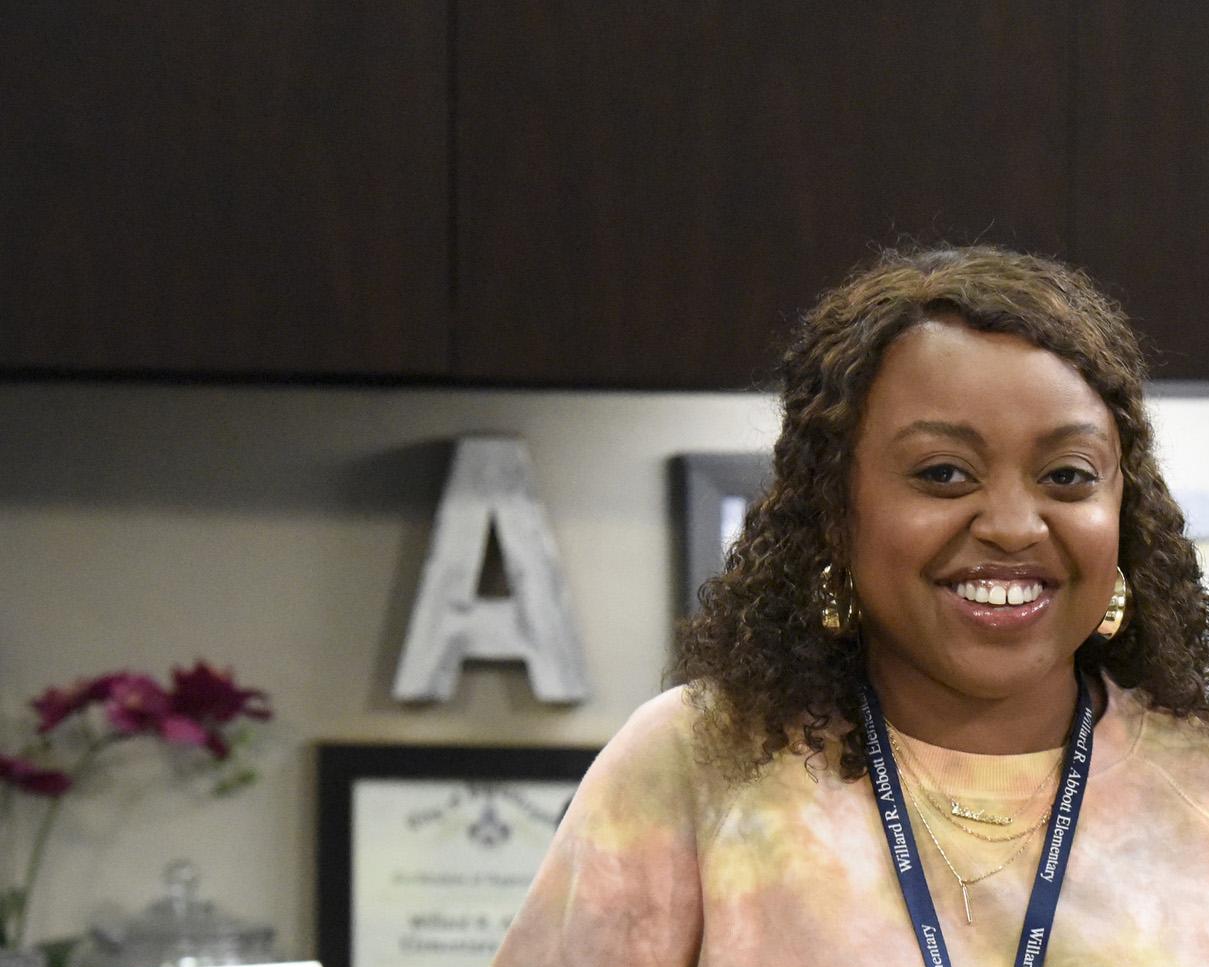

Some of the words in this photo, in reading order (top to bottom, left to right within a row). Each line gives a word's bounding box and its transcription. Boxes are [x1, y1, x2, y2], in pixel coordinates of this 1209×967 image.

[393, 438, 593, 702] A
[1076, 706, 1093, 753] Willard
[876, 758, 897, 802] Abbott
[1072, 750, 1087, 764] R.
[885, 804, 900, 822] R.
[1059, 766, 1083, 813] Abbott
[889, 823, 913, 873] Willard
[1040, 814, 1072, 883] Elementary
